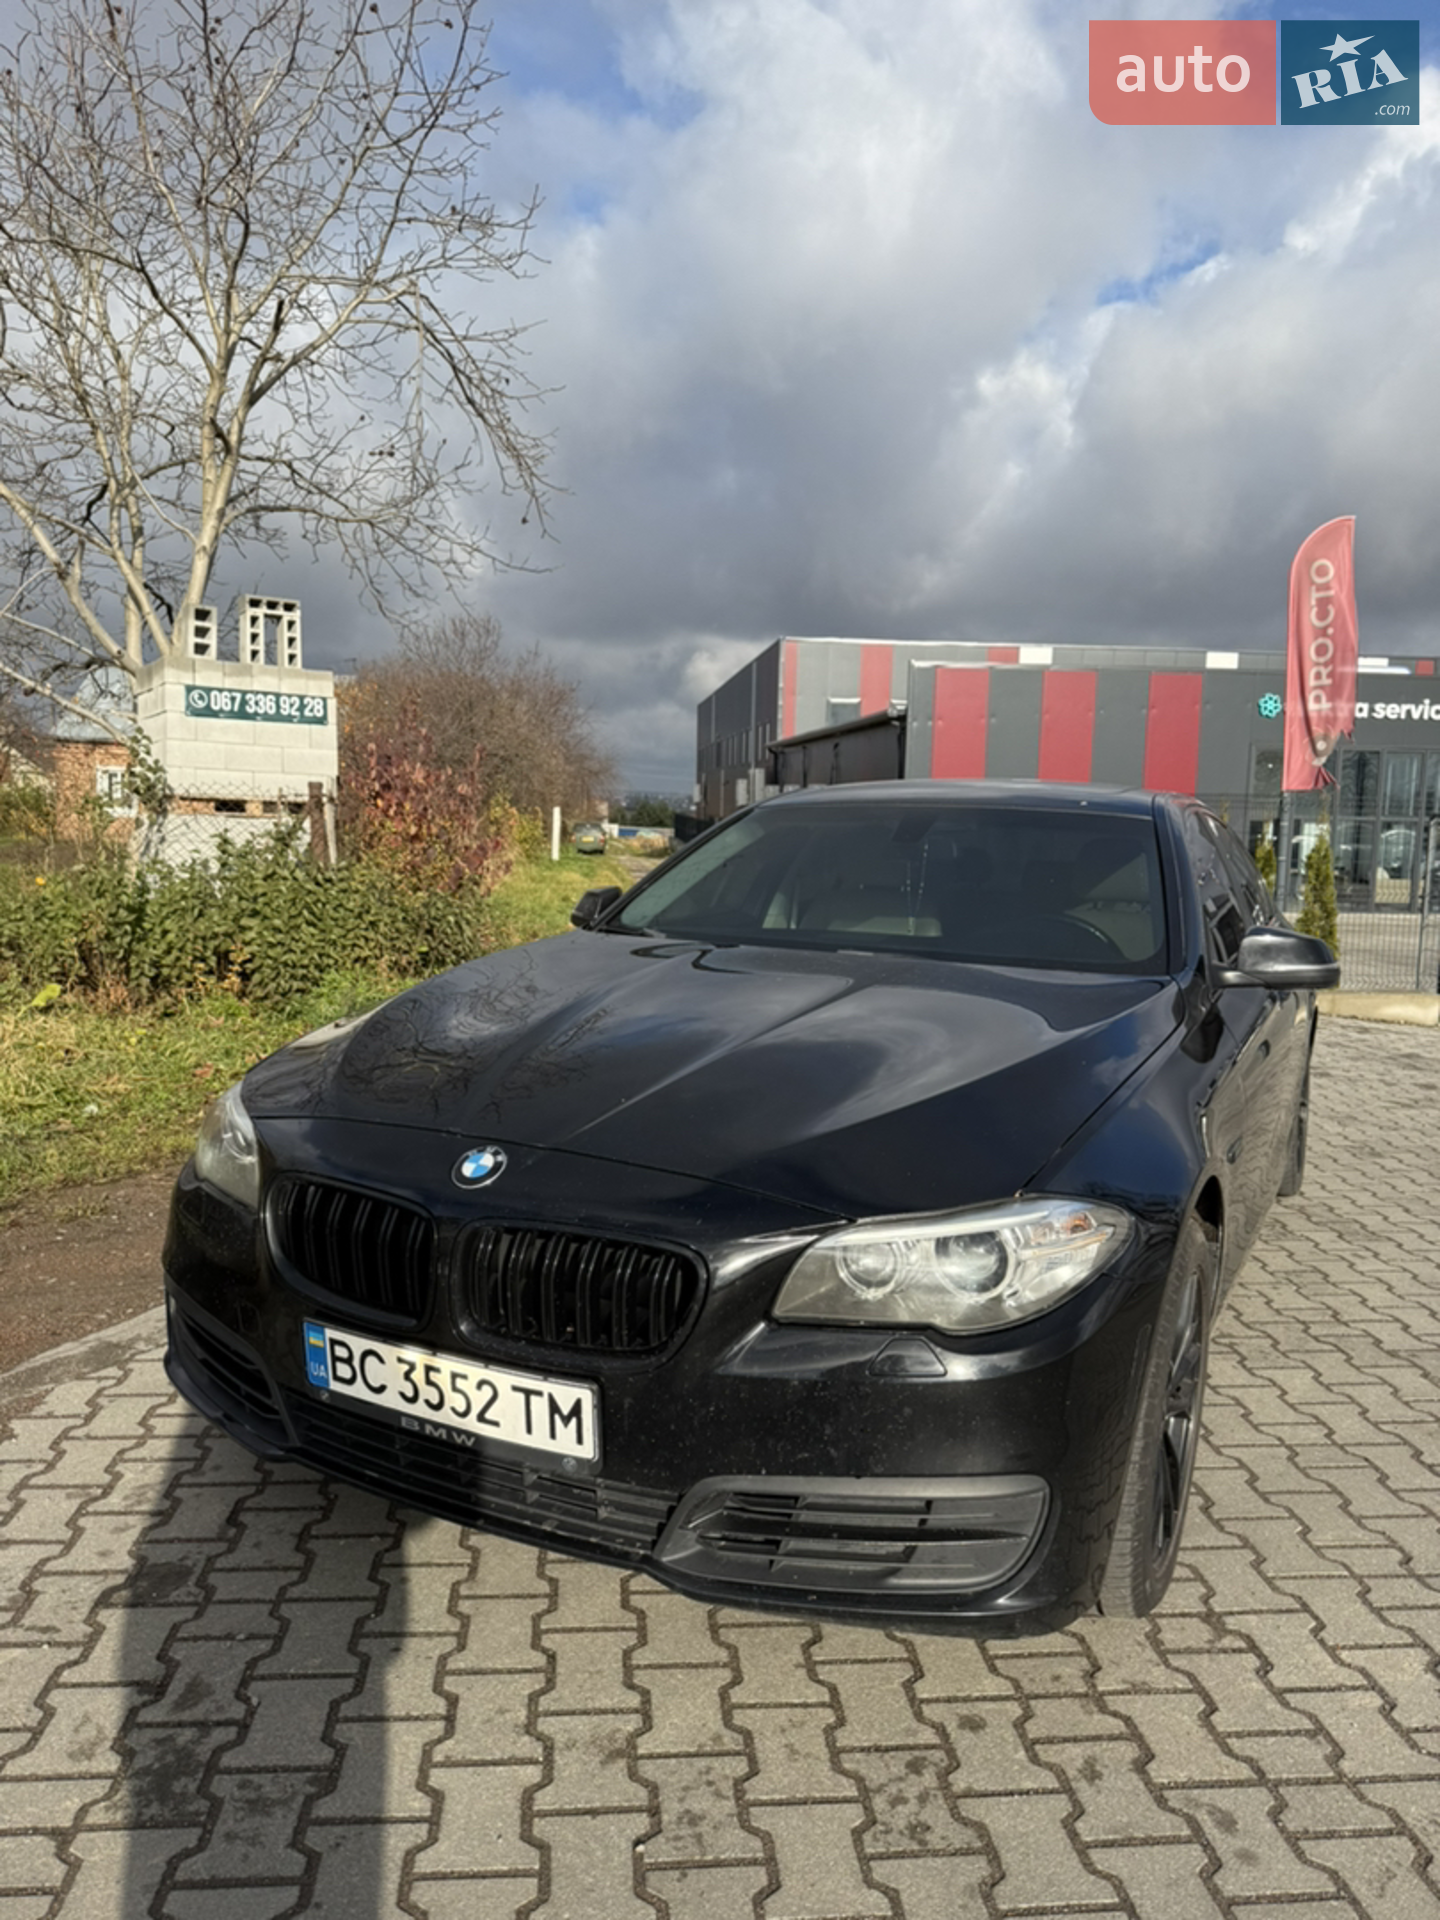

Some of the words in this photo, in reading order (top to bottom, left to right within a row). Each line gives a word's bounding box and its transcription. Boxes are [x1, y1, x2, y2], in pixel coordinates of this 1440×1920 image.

[209, 690, 241, 713] 067
[245, 693, 276, 715] 336
[279, 695, 300, 717] 92
[303, 697, 324, 718] 28
[309, 1362, 328, 1379] UA
[328, 1336, 387, 1395] BC
[396, 1355, 502, 1428] 3552
[511, 1384, 584, 1446] TM
[400, 1416, 476, 1447] BMW
